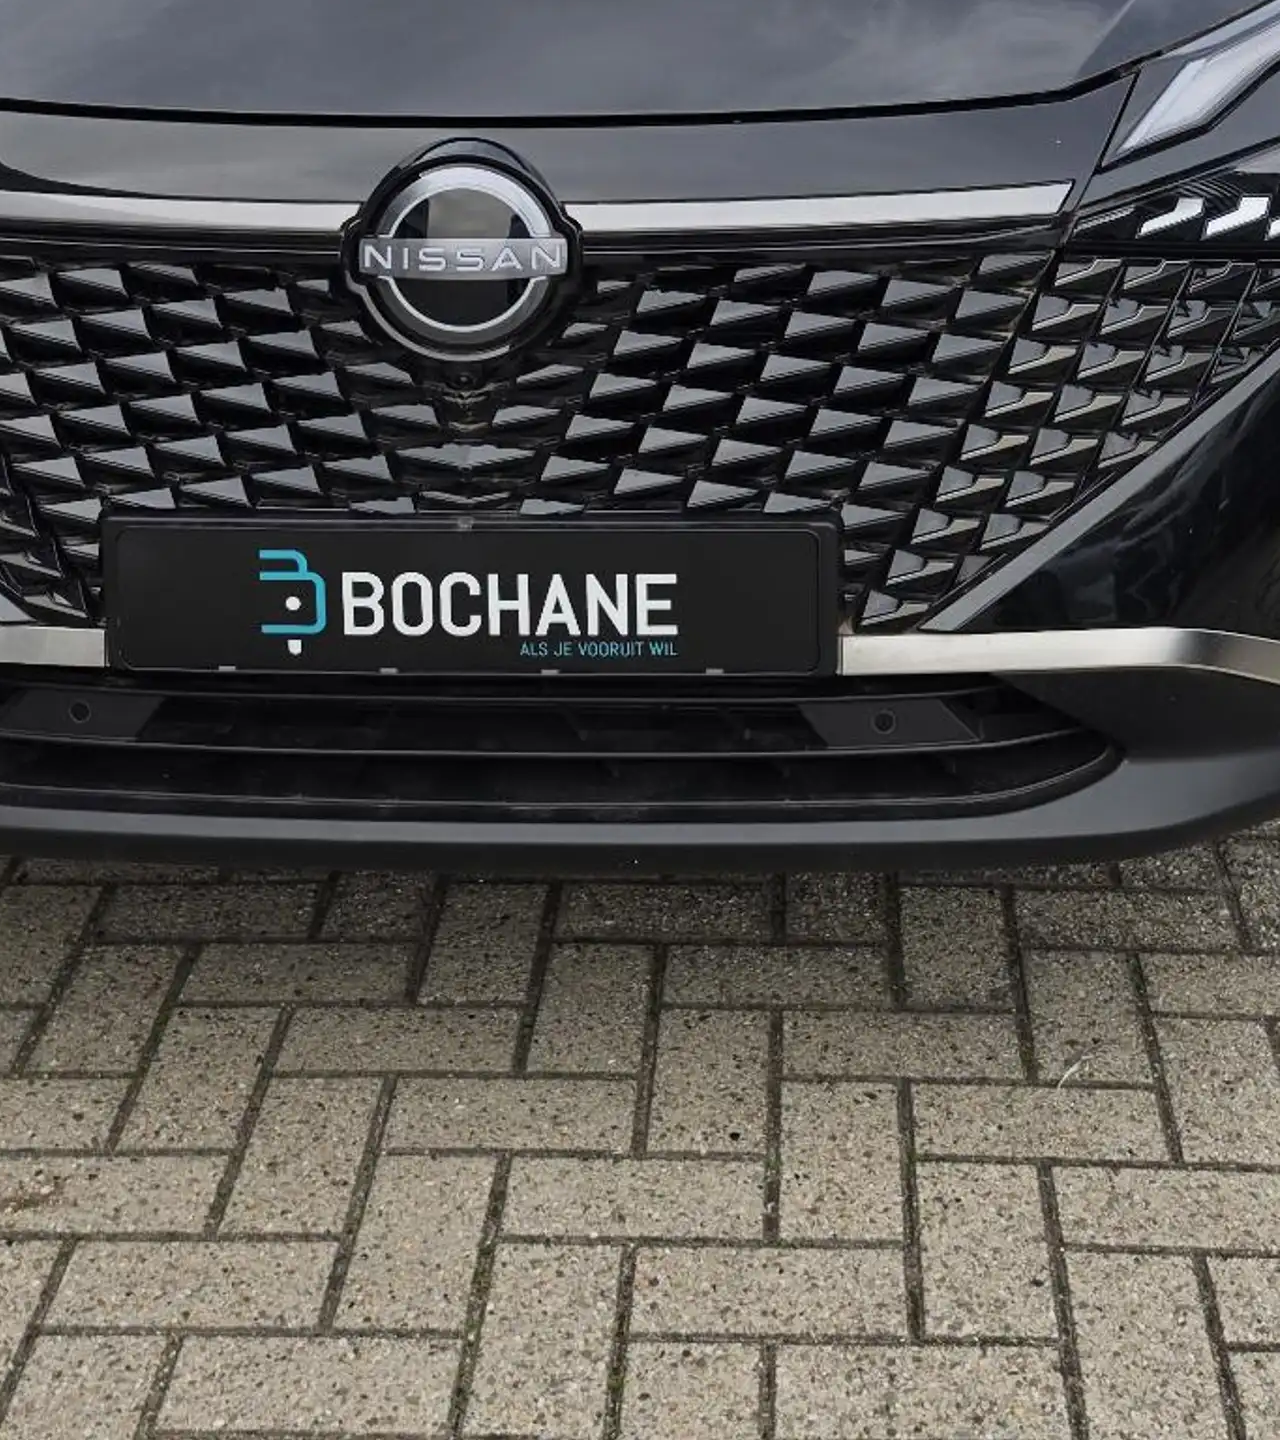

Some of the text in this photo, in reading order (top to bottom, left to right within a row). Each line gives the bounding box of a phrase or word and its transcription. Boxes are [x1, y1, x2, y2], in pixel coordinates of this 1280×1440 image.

[364, 245, 561, 272] NISSAN
[342, 571, 678, 636] BOCHANE
[520, 641, 678, 657] ALS JE VOORUIT WIL
